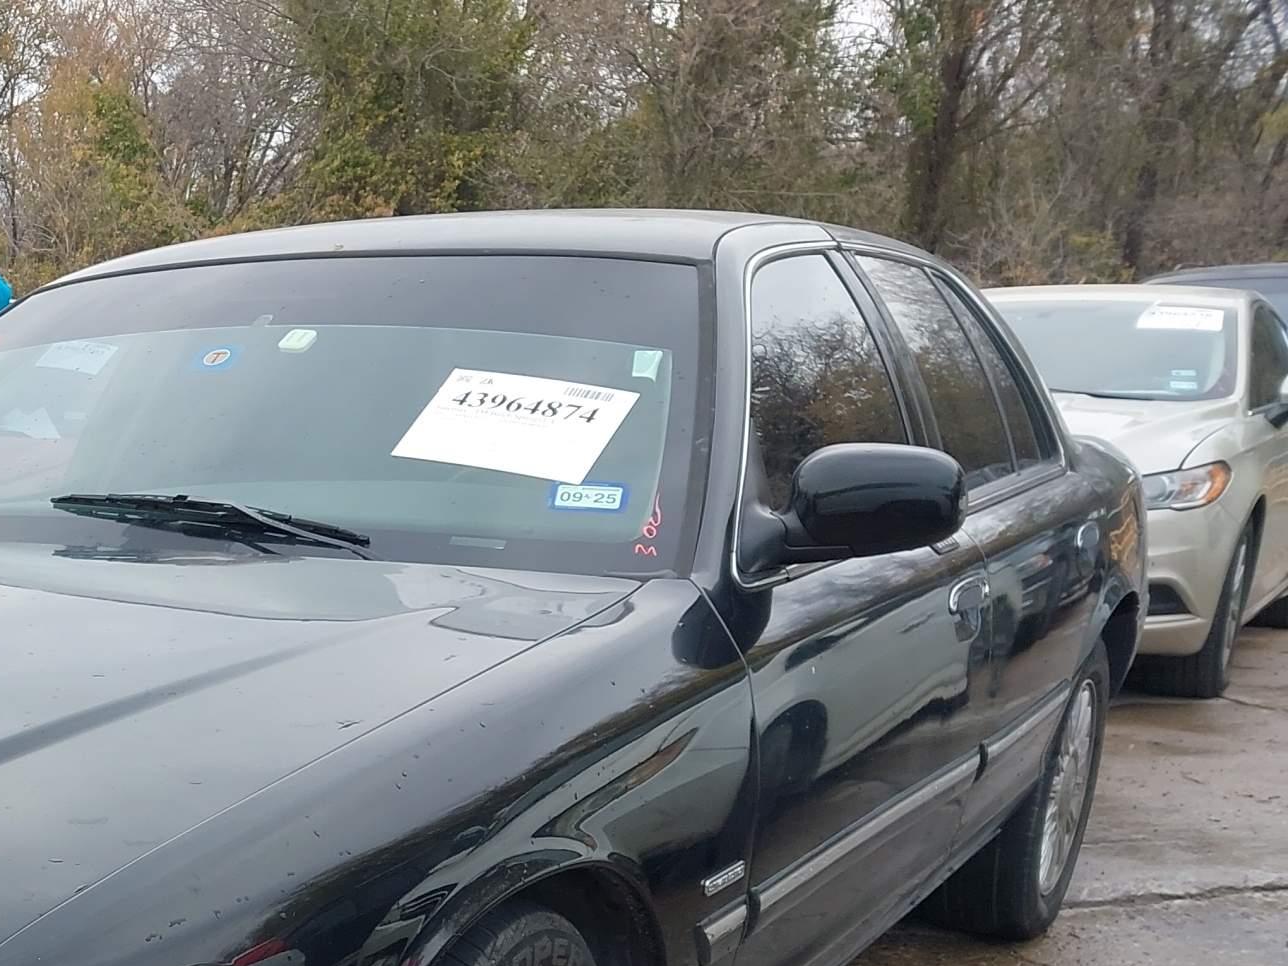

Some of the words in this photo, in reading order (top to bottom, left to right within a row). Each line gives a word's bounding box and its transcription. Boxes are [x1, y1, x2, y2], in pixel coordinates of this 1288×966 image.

[452, 389, 600, 424] 43964874
[560, 490, 583, 503] 09
[593, 492, 617, 504] 25
